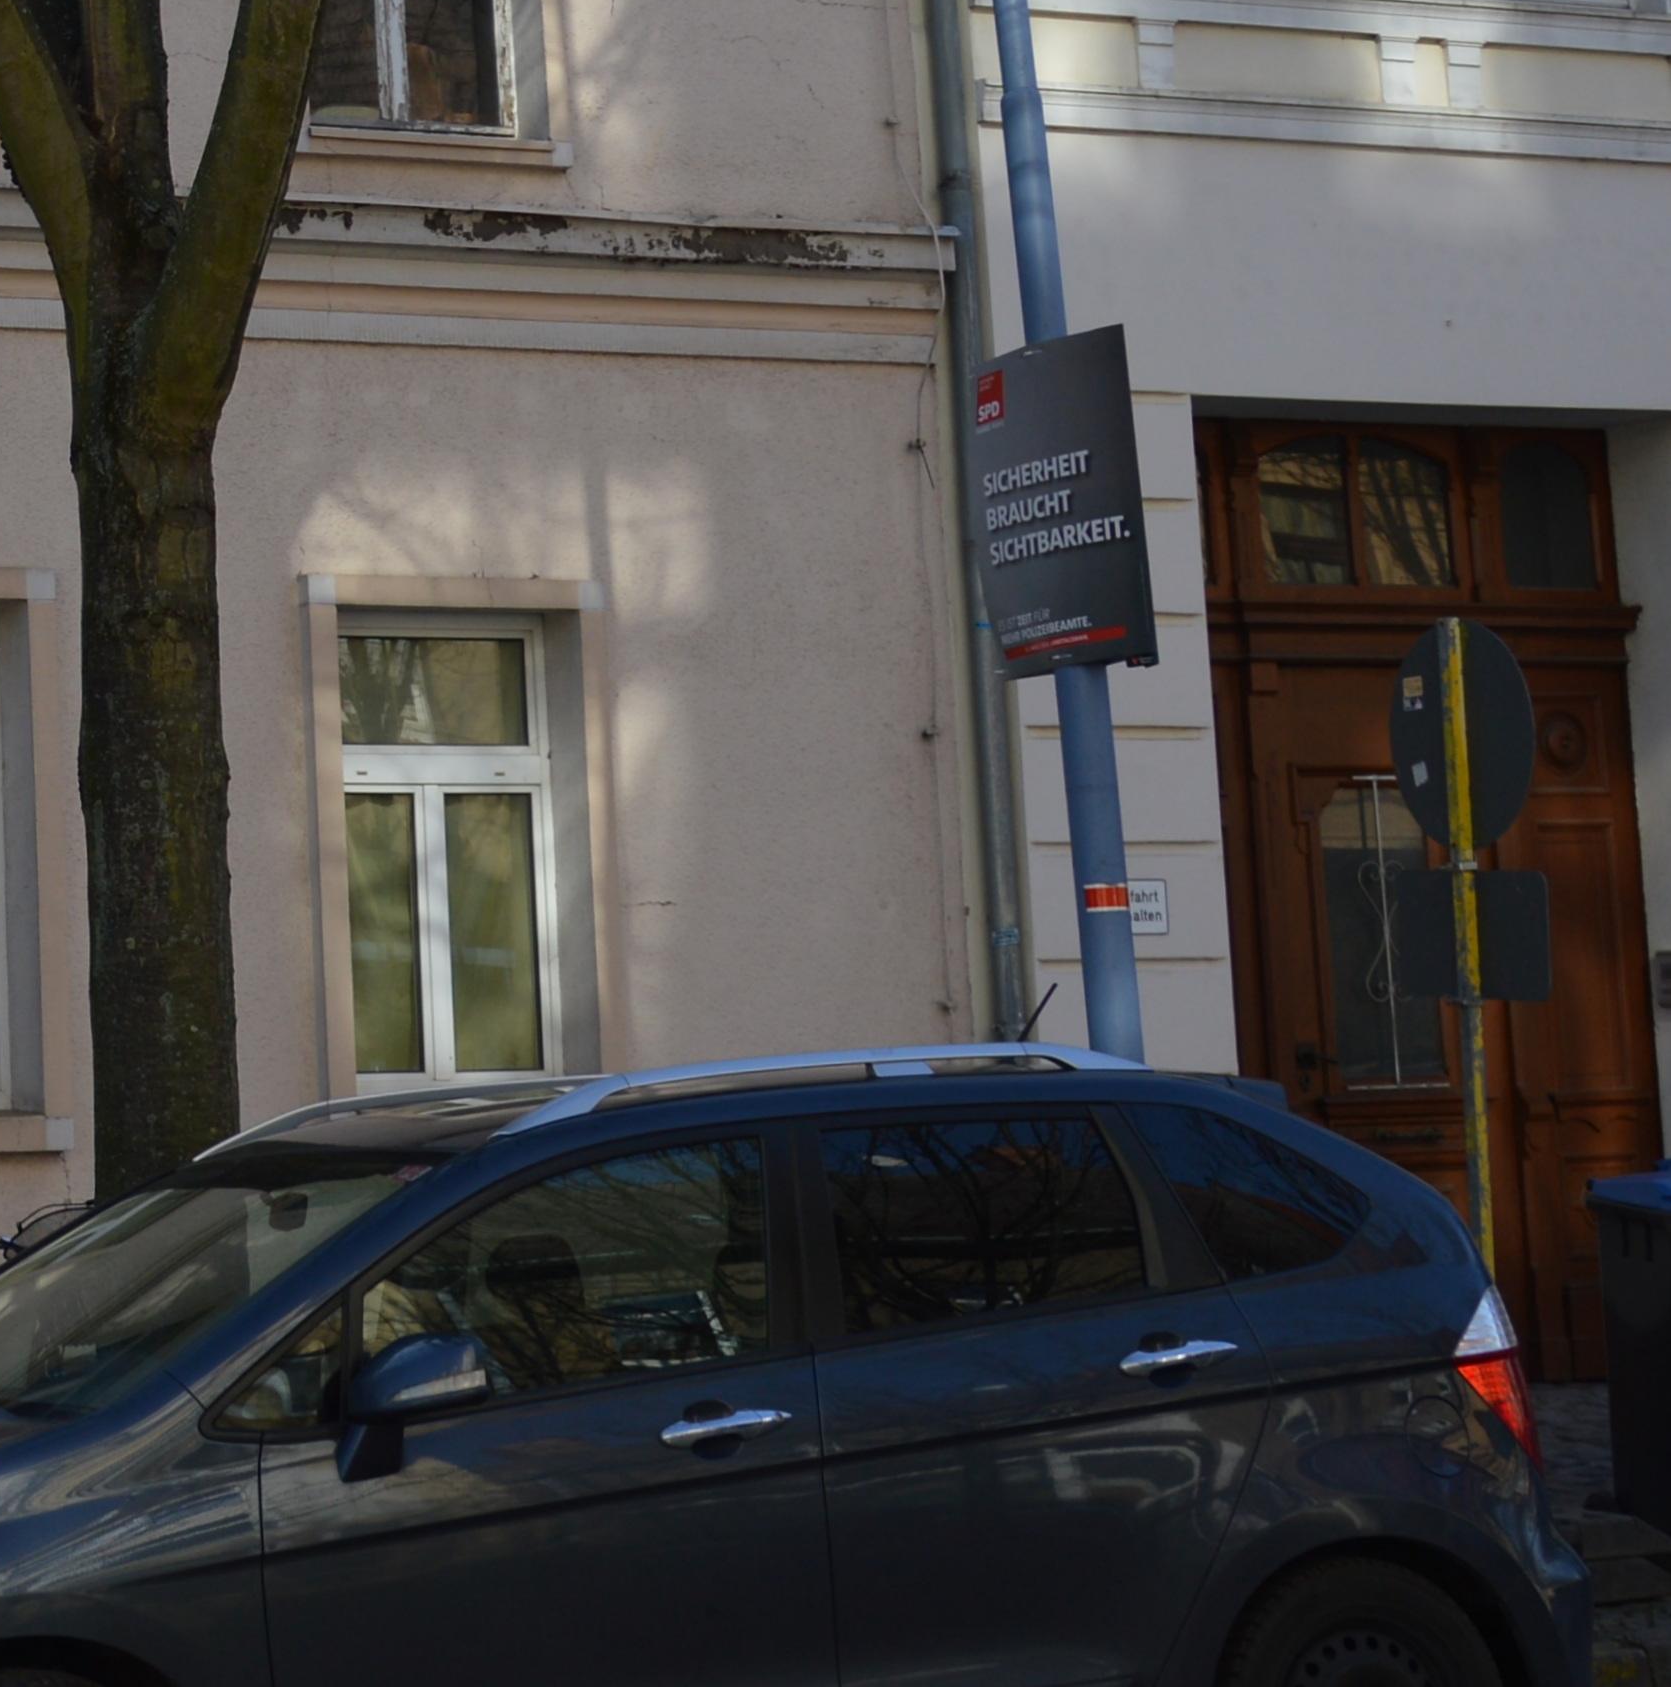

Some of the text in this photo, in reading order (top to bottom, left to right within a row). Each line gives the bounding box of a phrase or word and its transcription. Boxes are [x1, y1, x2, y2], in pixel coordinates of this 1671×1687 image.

[977, 400, 1000, 423] SPD
[983, 449, 1089, 497] SICHERHEIT
[986, 489, 1071, 531] BRAUCHT
[989, 515, 1131, 566] SICHTBARKEIT.
[1130, 890, 1159, 903] fahrt
[1133, 909, 1163, 922] alten
